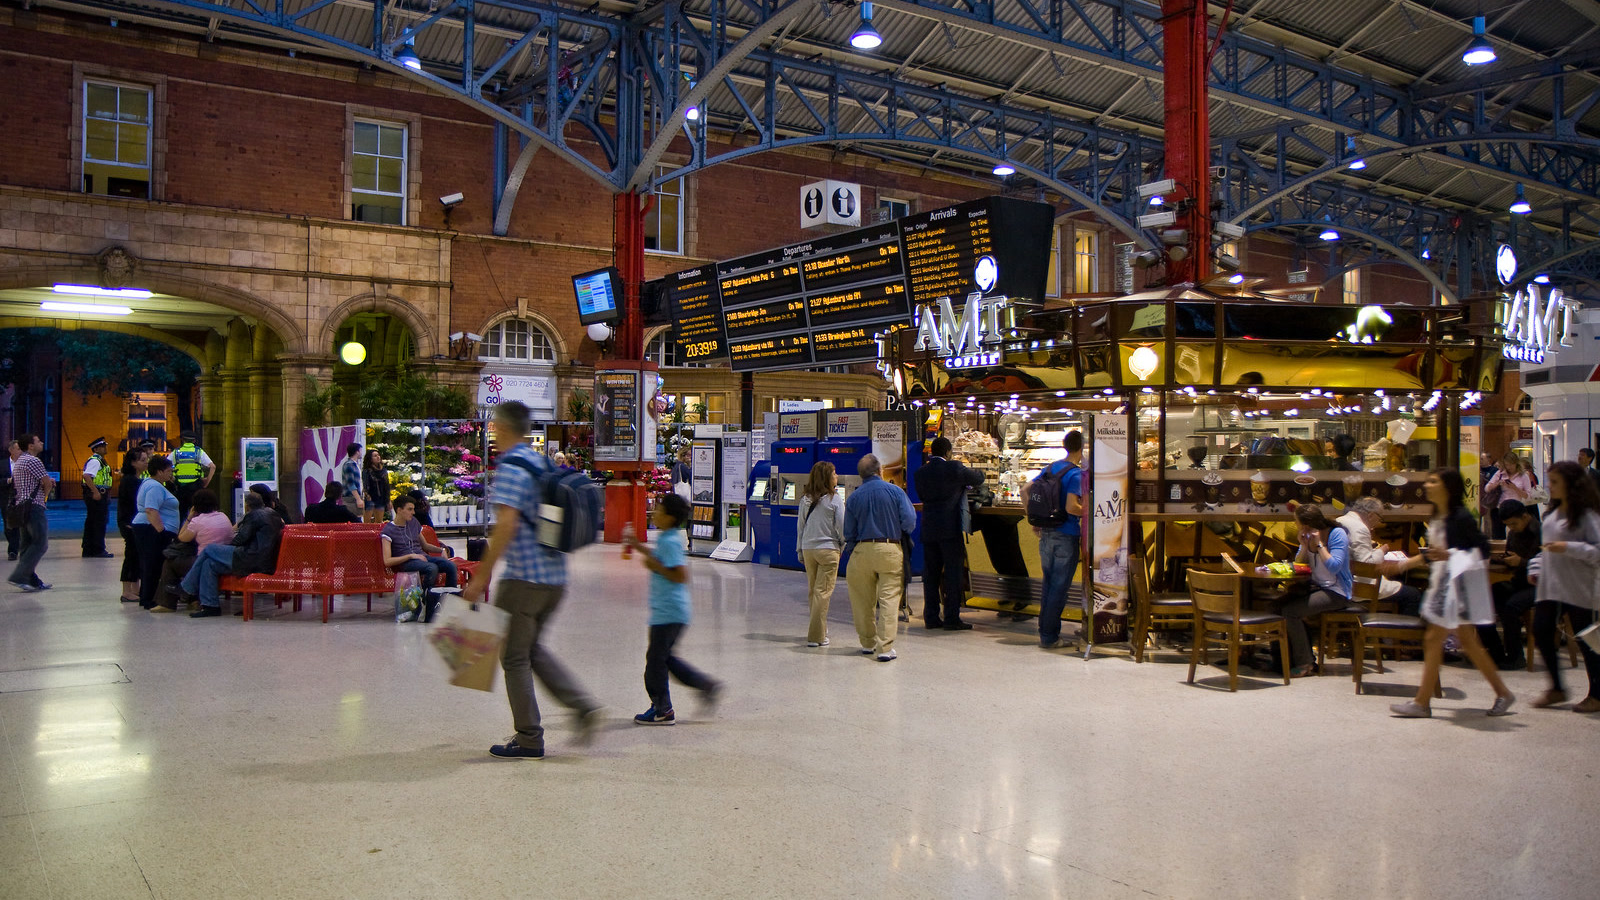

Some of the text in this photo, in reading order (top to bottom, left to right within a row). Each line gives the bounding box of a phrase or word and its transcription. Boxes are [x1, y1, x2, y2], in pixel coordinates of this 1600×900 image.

[930, 208, 957, 221] Arrivals
[968, 209, 986, 218] Expected
[784, 244, 812, 256] Departures
[836, 256, 850, 265] North
[888, 246, 898, 254] Time
[678, 270, 701, 280] Information
[823, 296, 845, 305] Aylesbury
[914, 292, 1008, 357] AMT
[1504, 284, 1582, 354] AMT
[945, 353, 997, 368] COFFEE
[782, 425, 800, 434] TICKET
[829, 423, 848, 433] TICKET
[1101, 624, 1120, 634] AMT
